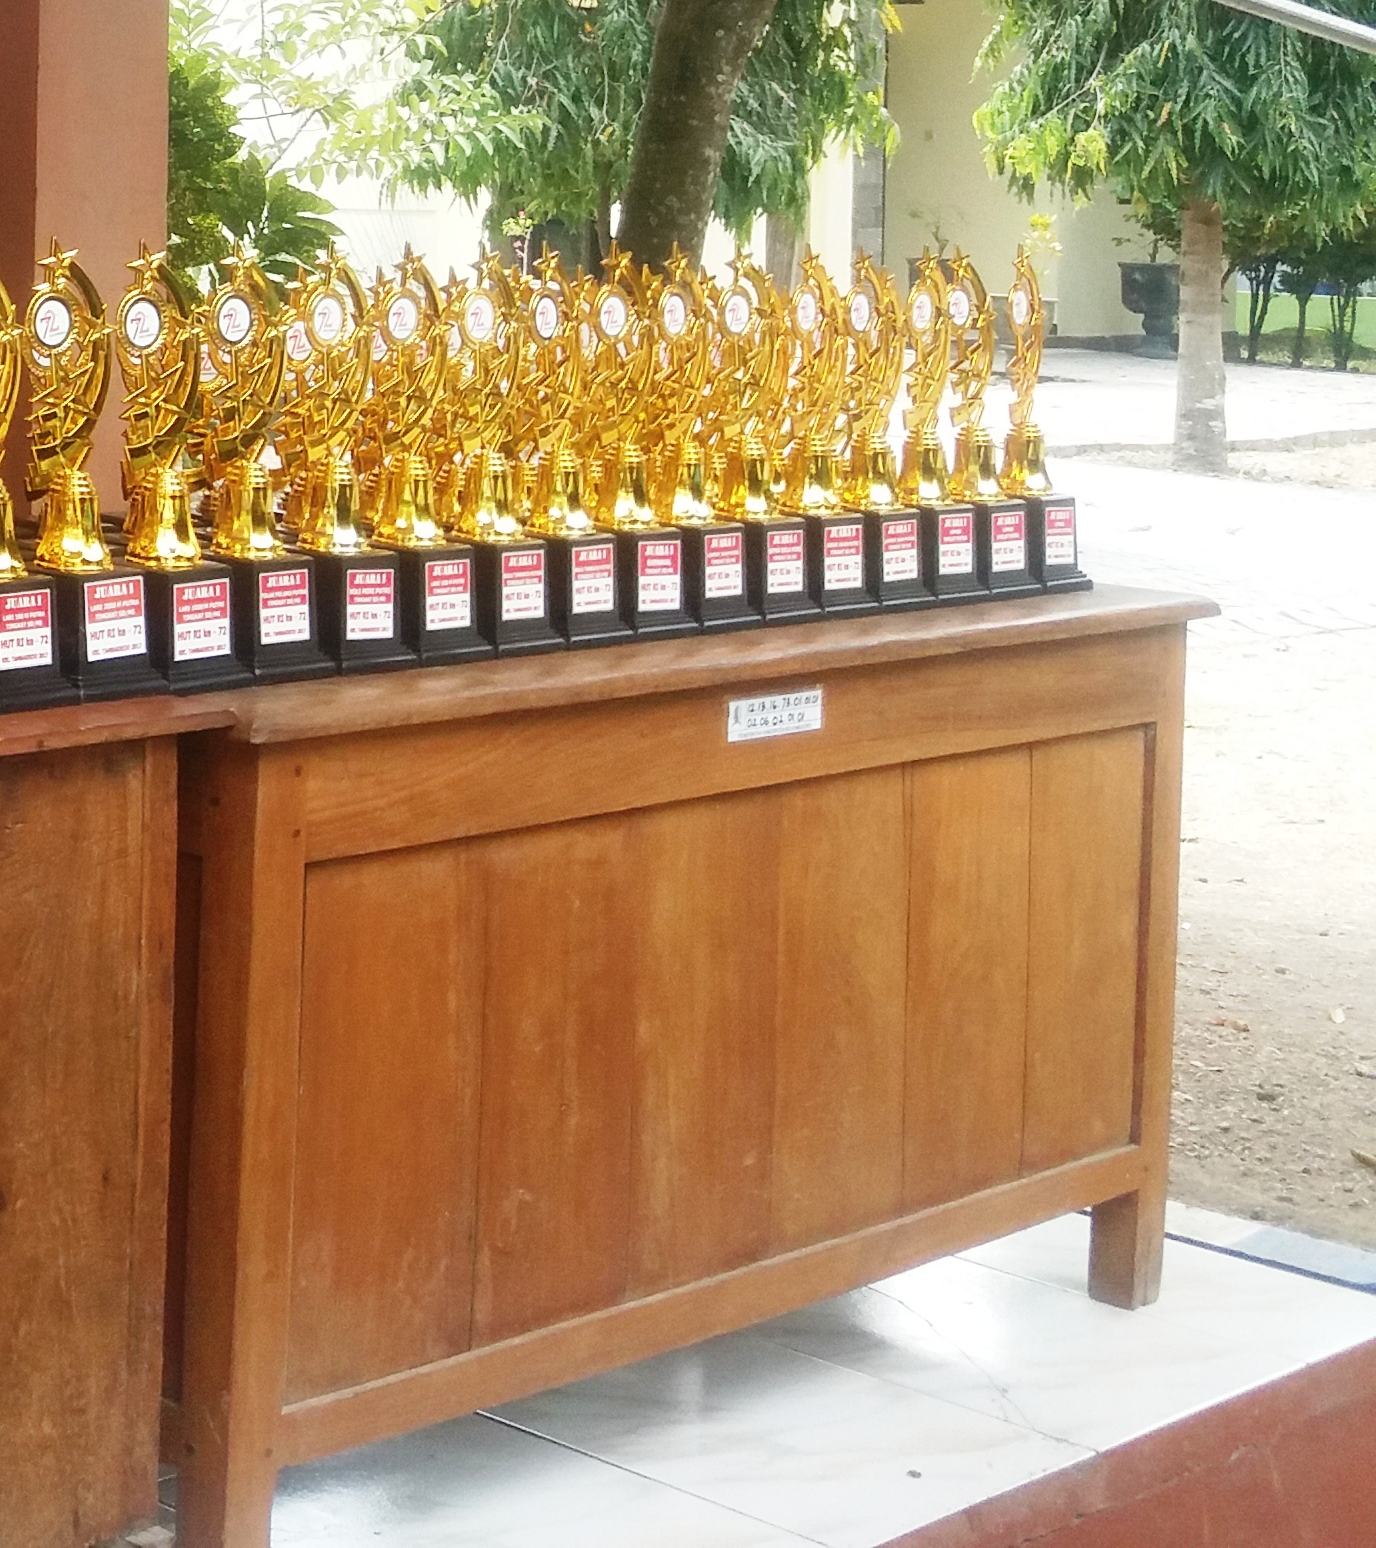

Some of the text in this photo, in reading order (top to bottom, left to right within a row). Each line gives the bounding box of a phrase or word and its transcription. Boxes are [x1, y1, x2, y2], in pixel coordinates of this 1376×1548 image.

[40, 310, 60, 339] 72
[130, 311, 150, 339] 72
[432, 565, 457, 577] JUARA
[267, 577, 294, 588] JUARA
[182, 586, 214, 601] JUARA
